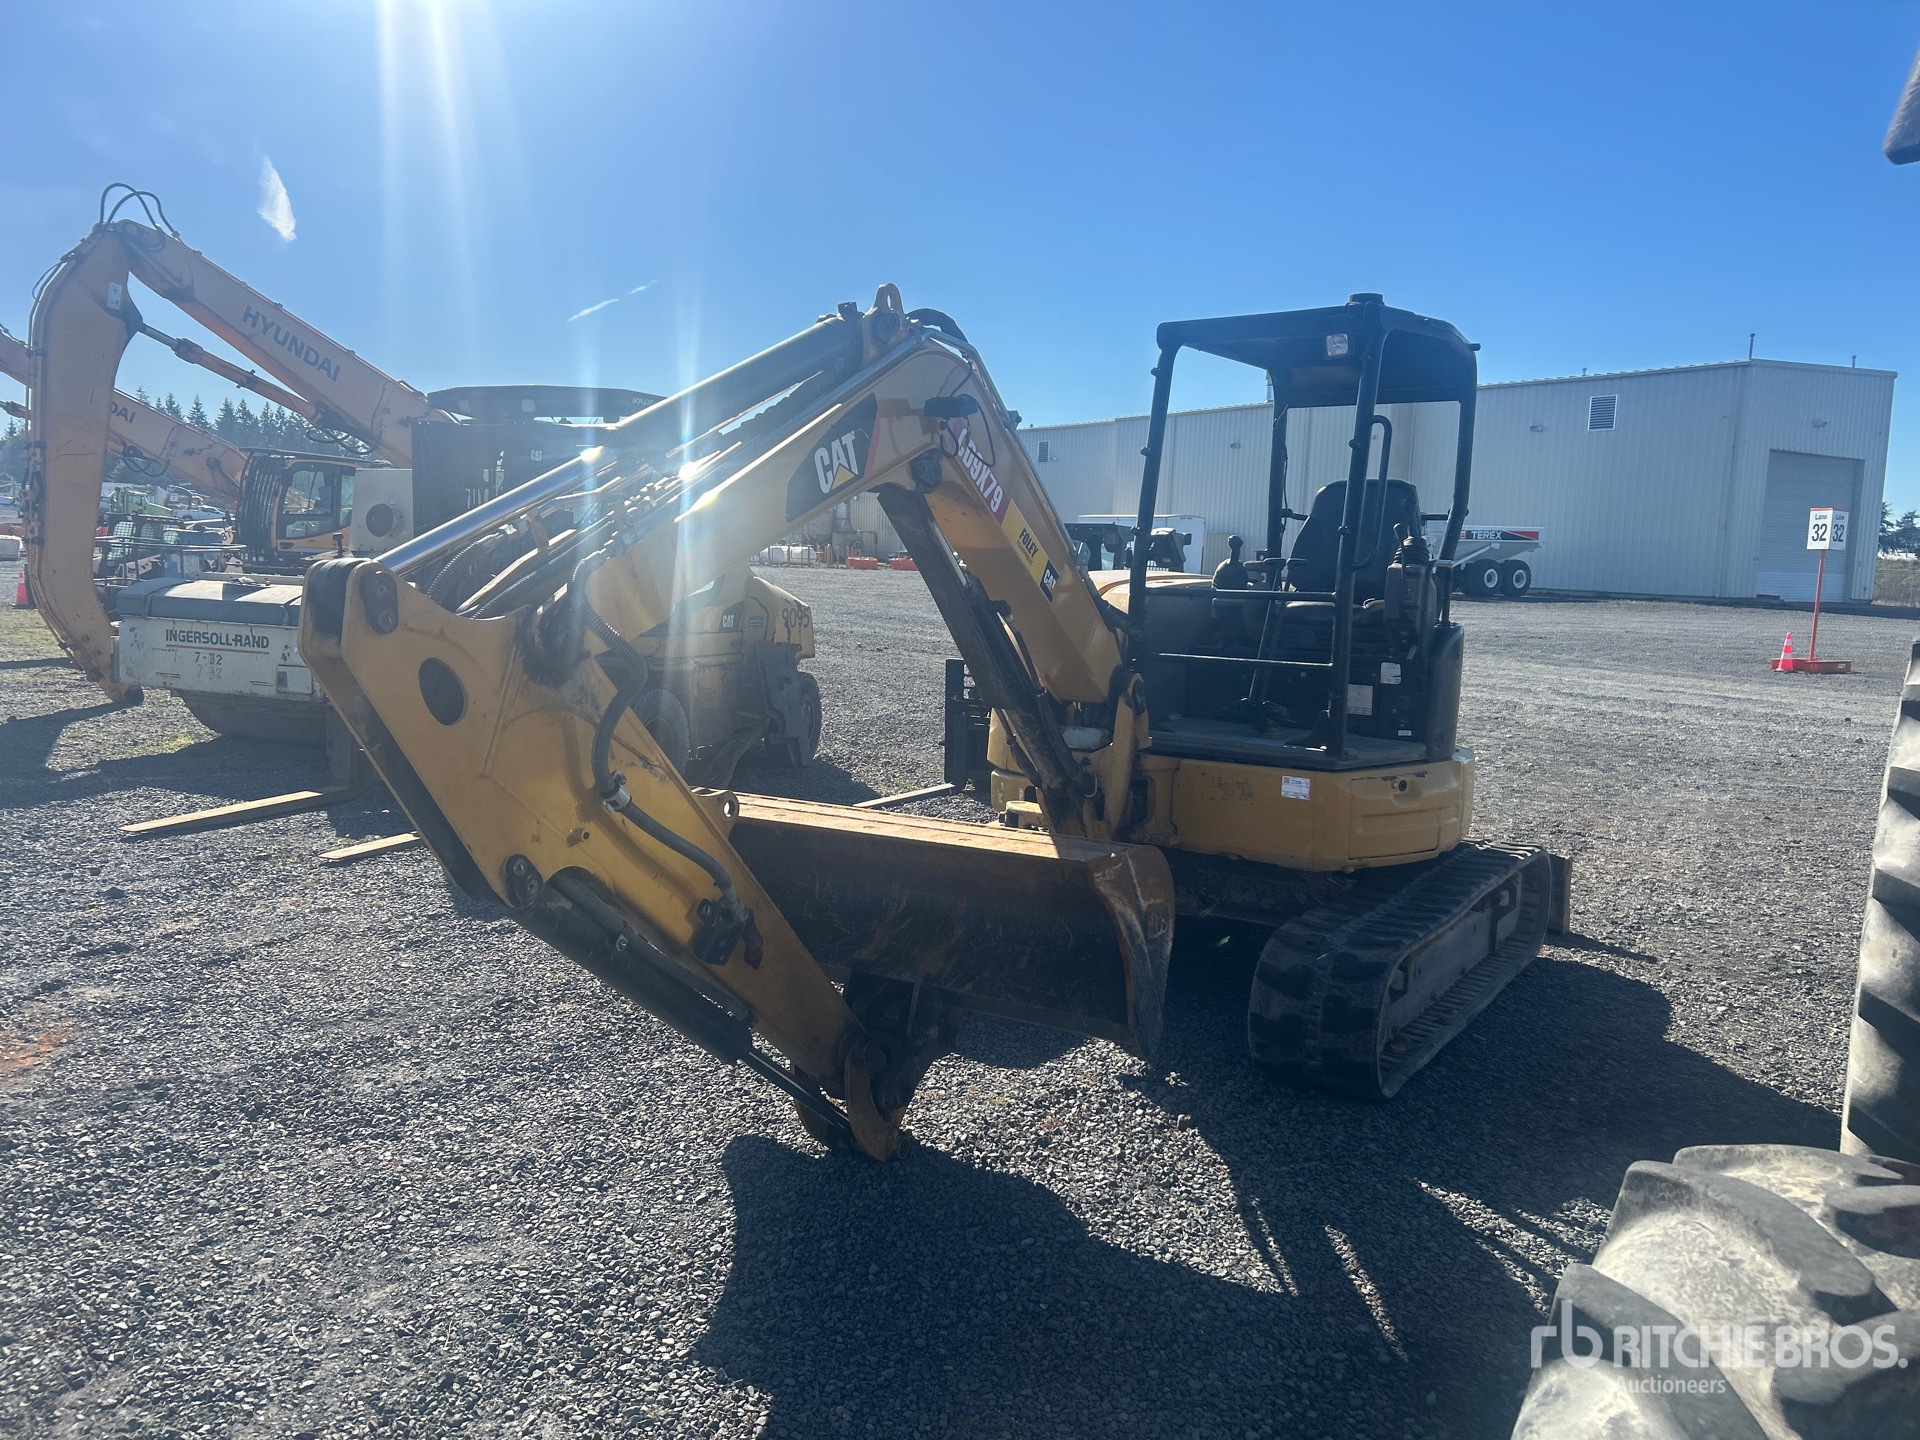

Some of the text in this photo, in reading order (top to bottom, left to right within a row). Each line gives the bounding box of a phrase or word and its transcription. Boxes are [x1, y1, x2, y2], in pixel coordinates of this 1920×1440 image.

[242, 304, 341, 382] HYUNDAI
[530, 449, 543, 462] CAT
[814, 430, 859, 494] CAT
[1018, 527, 1039, 558] FOLEY
[1471, 530, 1502, 540] TEREX
[1811, 523, 1828, 542] 32
[1832, 523, 1845, 543] 32
[1043, 568, 1057, 589] CAT
[722, 614, 735, 628] CAT
[782, 607, 810, 629] 9095
[165, 628, 270, 649] INGERSOLL-RAND
